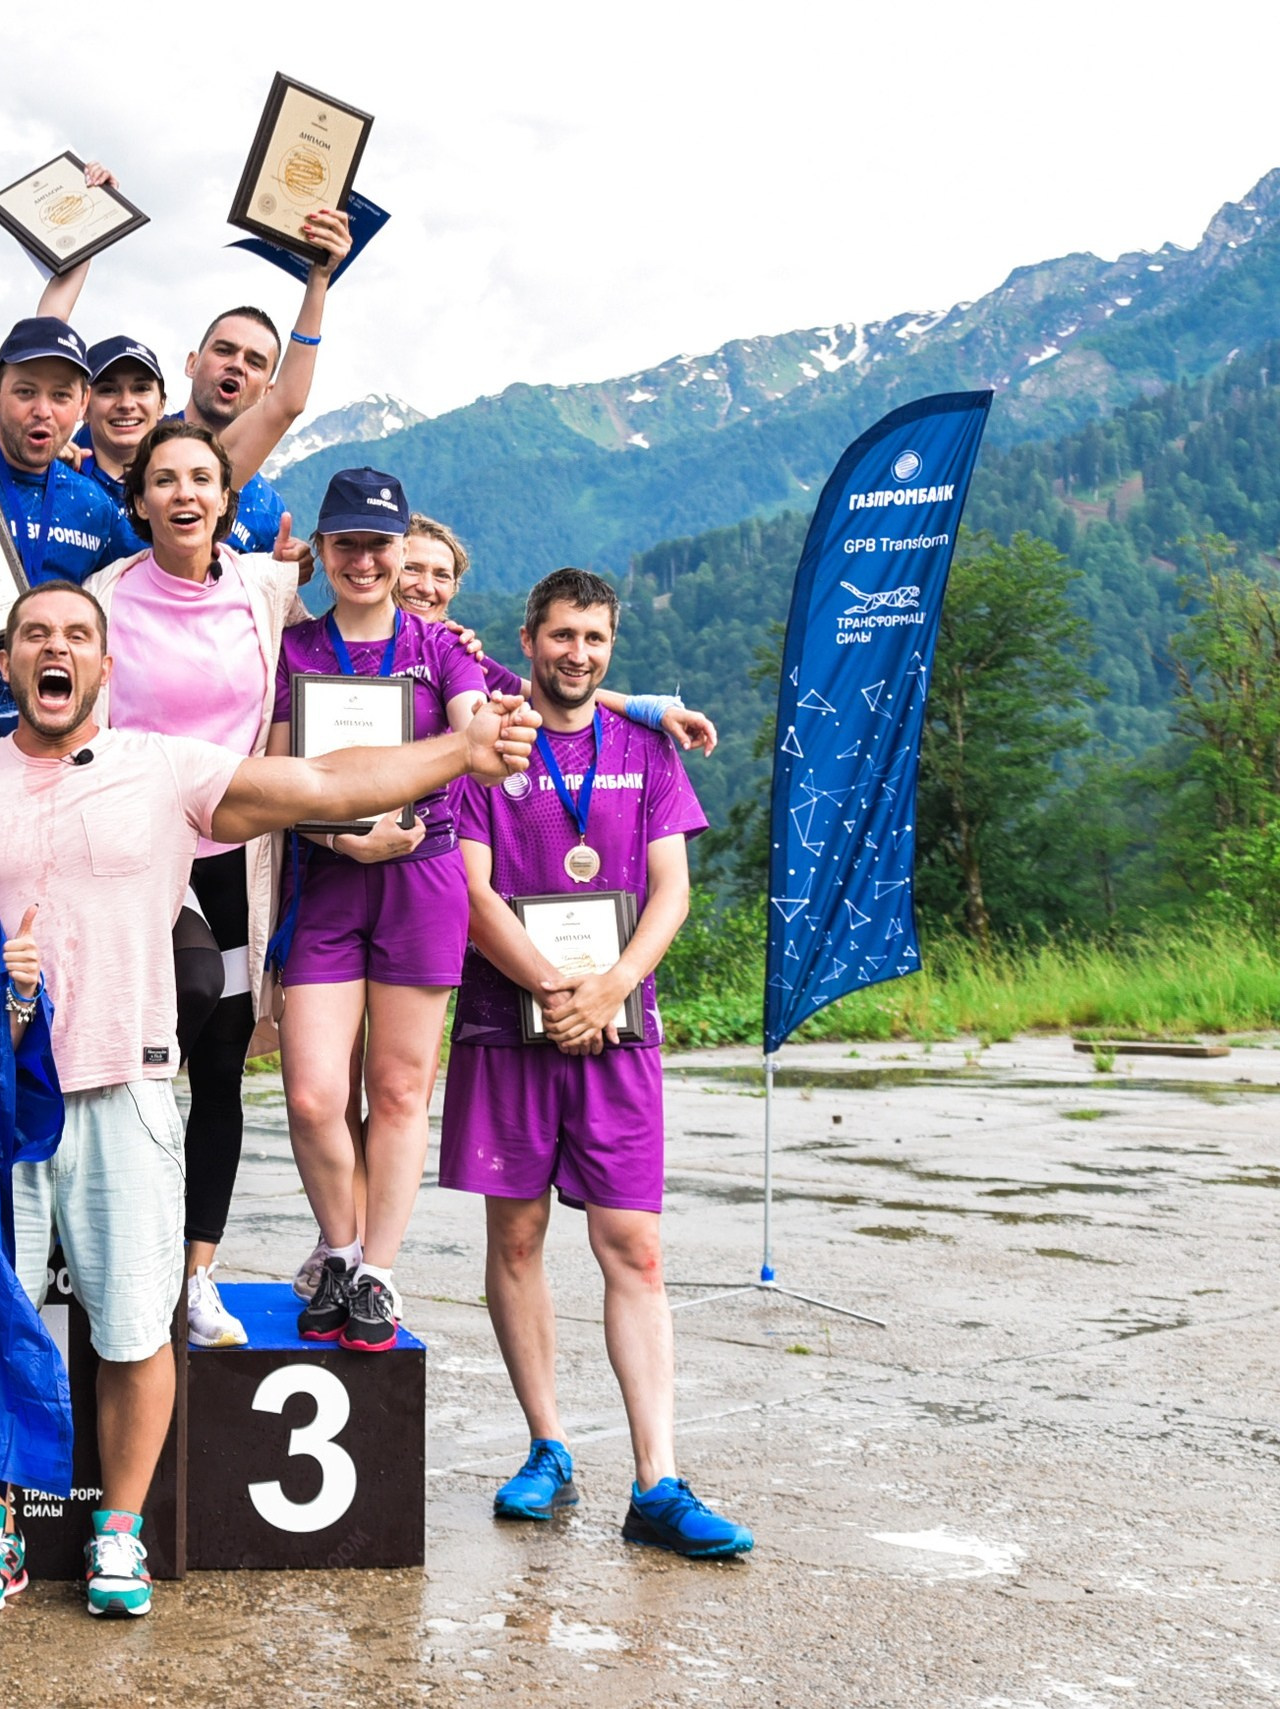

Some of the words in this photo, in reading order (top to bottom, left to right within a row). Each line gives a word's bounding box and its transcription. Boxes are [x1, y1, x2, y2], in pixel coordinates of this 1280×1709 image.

[299, 131, 331, 151] ДИПЛОМ
[849, 484, 955, 511] ГАЗПРОМБАНК
[843, 538, 876, 554] GPB
[880, 533, 949, 552] Transform
[836, 611, 927, 629] ТРАНСФОРМАЦ
[836, 631, 872, 645] СИЛЫ
[538, 772, 643, 791] ГАПРМБАНК
[247, 1363, 357, 1533] 3
[23, 1503, 63, 1518] СИЛЫ
